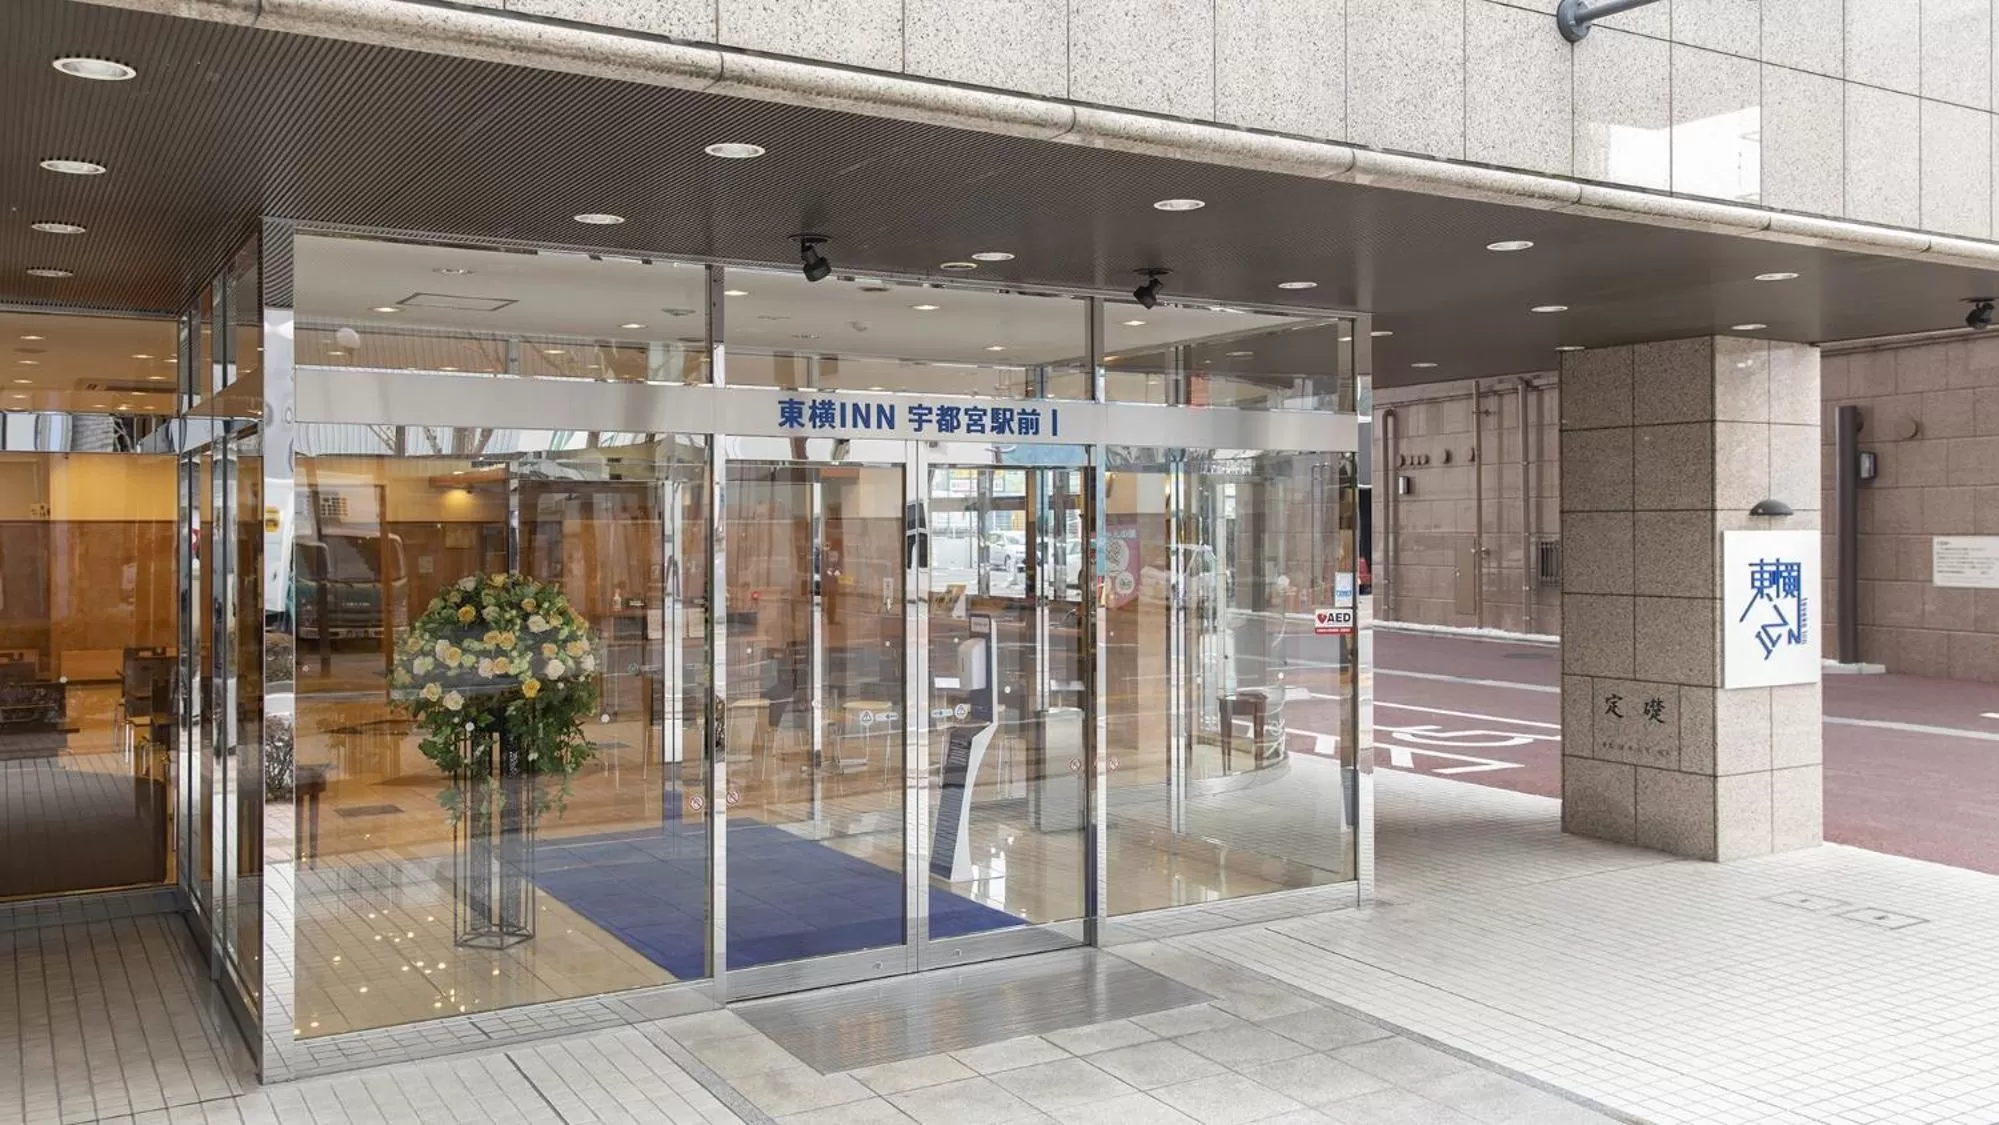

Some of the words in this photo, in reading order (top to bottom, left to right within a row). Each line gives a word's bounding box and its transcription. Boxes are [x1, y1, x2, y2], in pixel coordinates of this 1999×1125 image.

[778, 399, 895, 430] 東横INN
[908, 406, 1041, 436] 宇都宮駅前
[1327, 613, 1351, 622] AED
